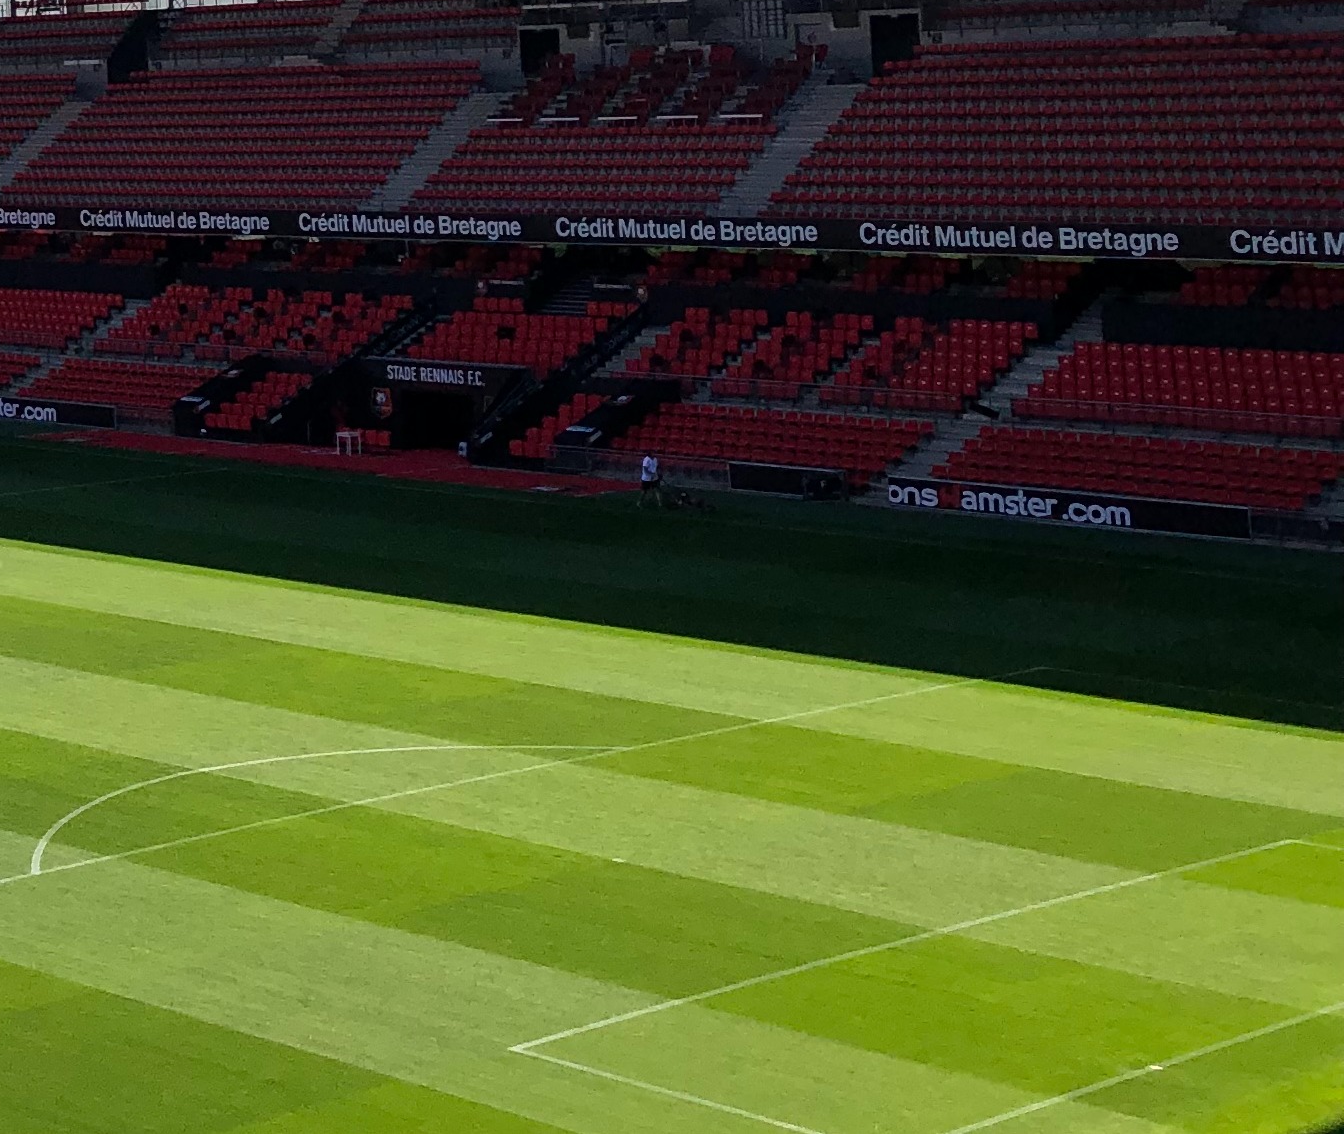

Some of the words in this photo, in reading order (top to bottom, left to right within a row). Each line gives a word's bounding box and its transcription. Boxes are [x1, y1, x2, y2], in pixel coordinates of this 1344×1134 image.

[79, 209, 124, 228] Crédit
[125, 210, 175, 229] Mutuel
[177, 211, 197, 230] de
[199, 212, 270, 235] Bretagne
[298, 212, 350, 232] Crédit
[352, 214, 411, 234] Mutuel
[413, 215, 435, 235] de
[438, 216, 522, 241] Bretagne
[555, 216, 615, 238] Crédit
[618, 217, 687, 240] Mutuel
[690, 218, 716, 242] de
[719, 220, 818, 248] Bretagne
[859, 222, 931, 246] Crédit
[935, 225, 1016, 248] Mutuel
[1021, 226, 1054, 249] de
[1058, 227, 1179, 256] Bretagne
[1230, 229, 1318, 255] Crédit
[387, 365, 417, 382] STADE
[420, 366, 465, 385] RENNAIS
